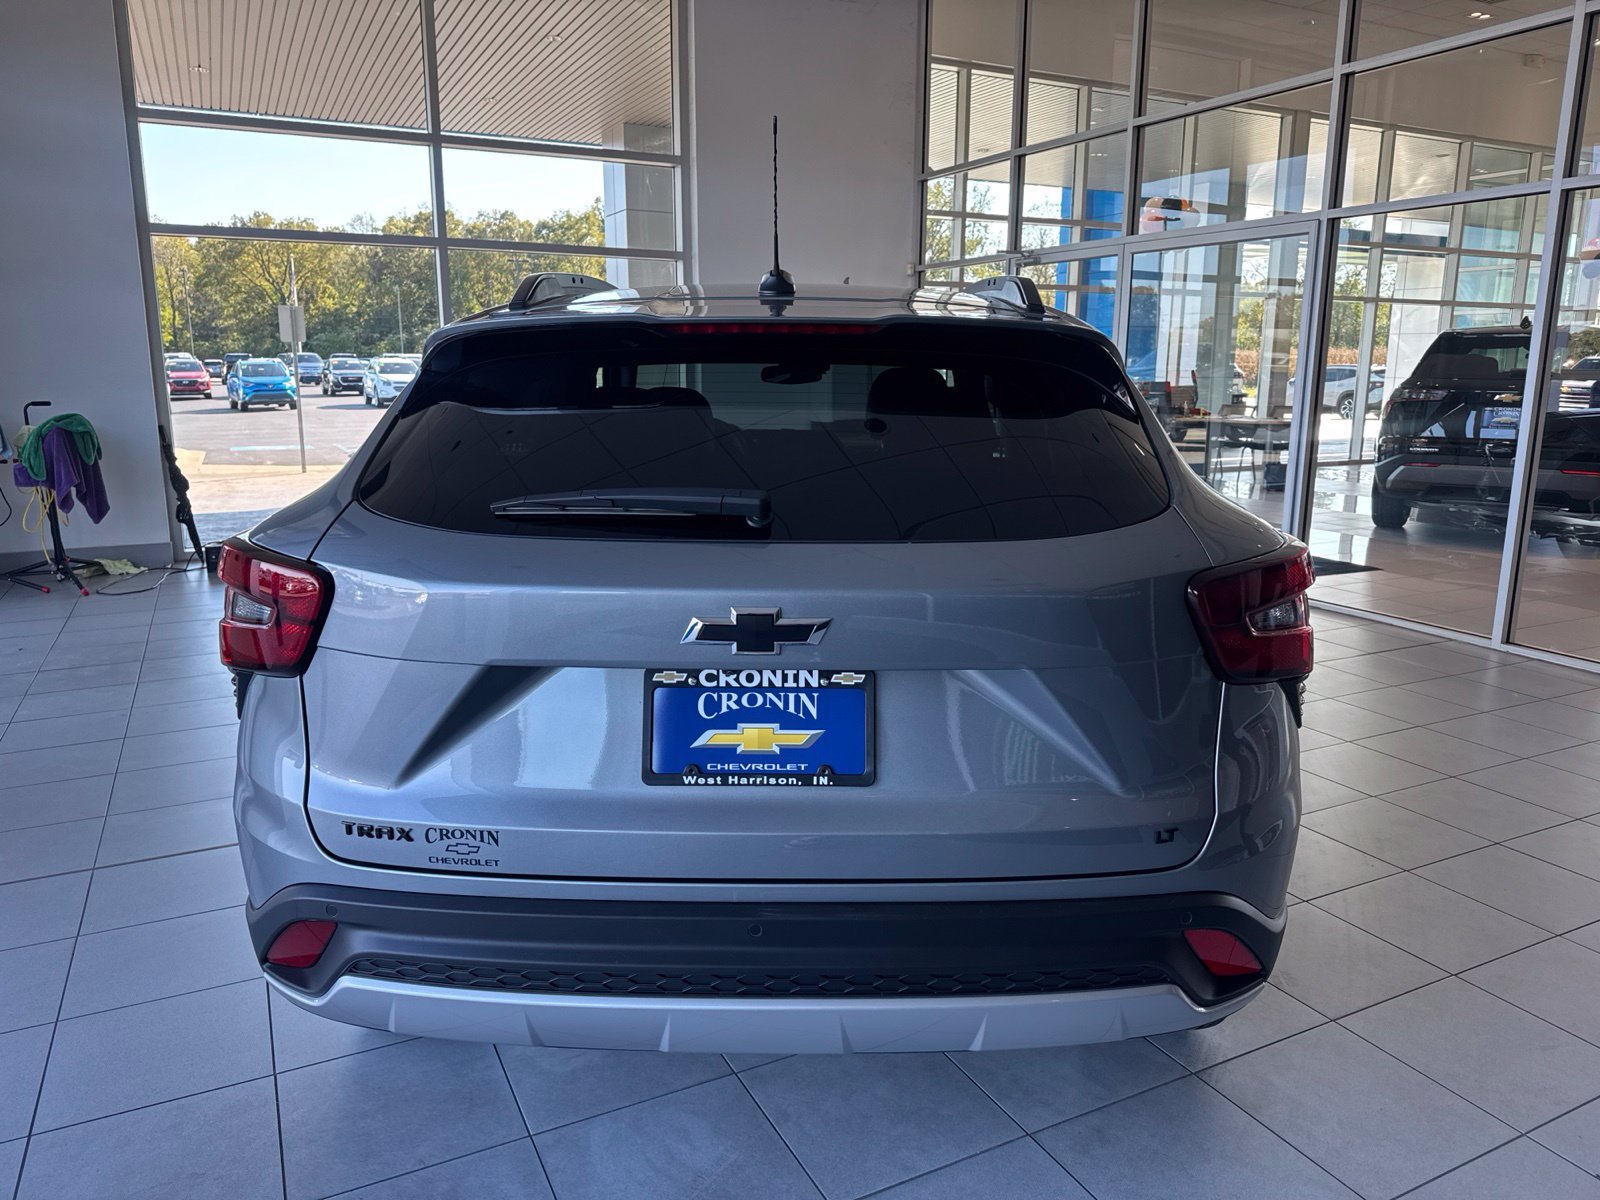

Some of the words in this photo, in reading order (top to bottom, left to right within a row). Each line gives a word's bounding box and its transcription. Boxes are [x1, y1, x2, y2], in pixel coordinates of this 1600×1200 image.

[698, 669, 819, 688] CRONIN
[697, 692, 819, 720] CRONIN
[706, 763, 809, 771] CHEVROLET
[682, 775, 722, 785] West
[728, 775, 802, 786] Harrison,
[813, 775, 834, 786] IN.
[341, 820, 415, 842] TRAX
[425, 827, 500, 848] CRONIN
[1154, 828, 1179, 845] LT
[428, 856, 500, 867] CHEVROLET
